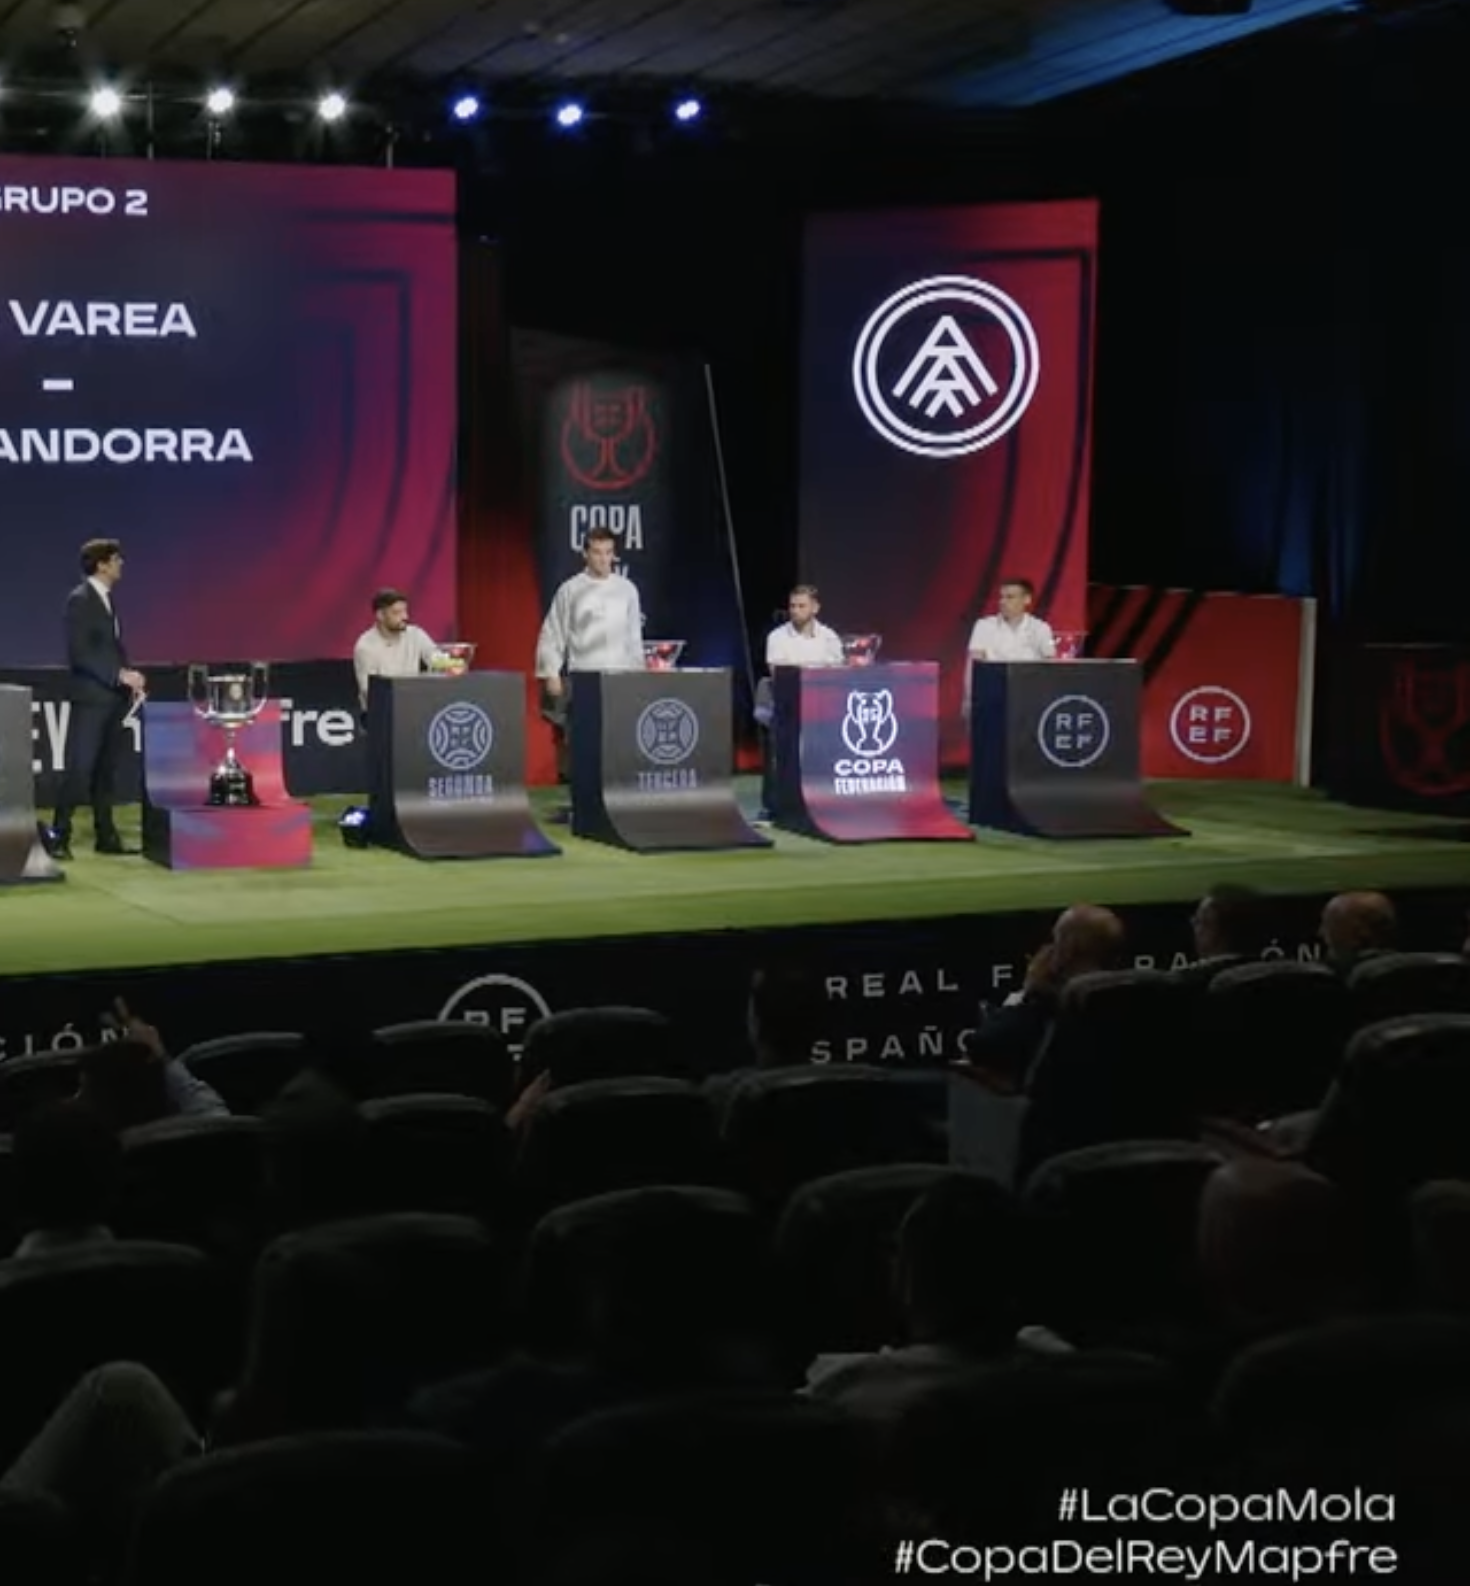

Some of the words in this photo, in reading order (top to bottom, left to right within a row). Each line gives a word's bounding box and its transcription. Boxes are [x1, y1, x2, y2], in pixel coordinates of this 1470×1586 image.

[125, 190, 148, 215] 2
[9, 300, 197, 338] VAREA
[834, 759, 904, 776] COPA
[824, 968, 960, 999] REAL
